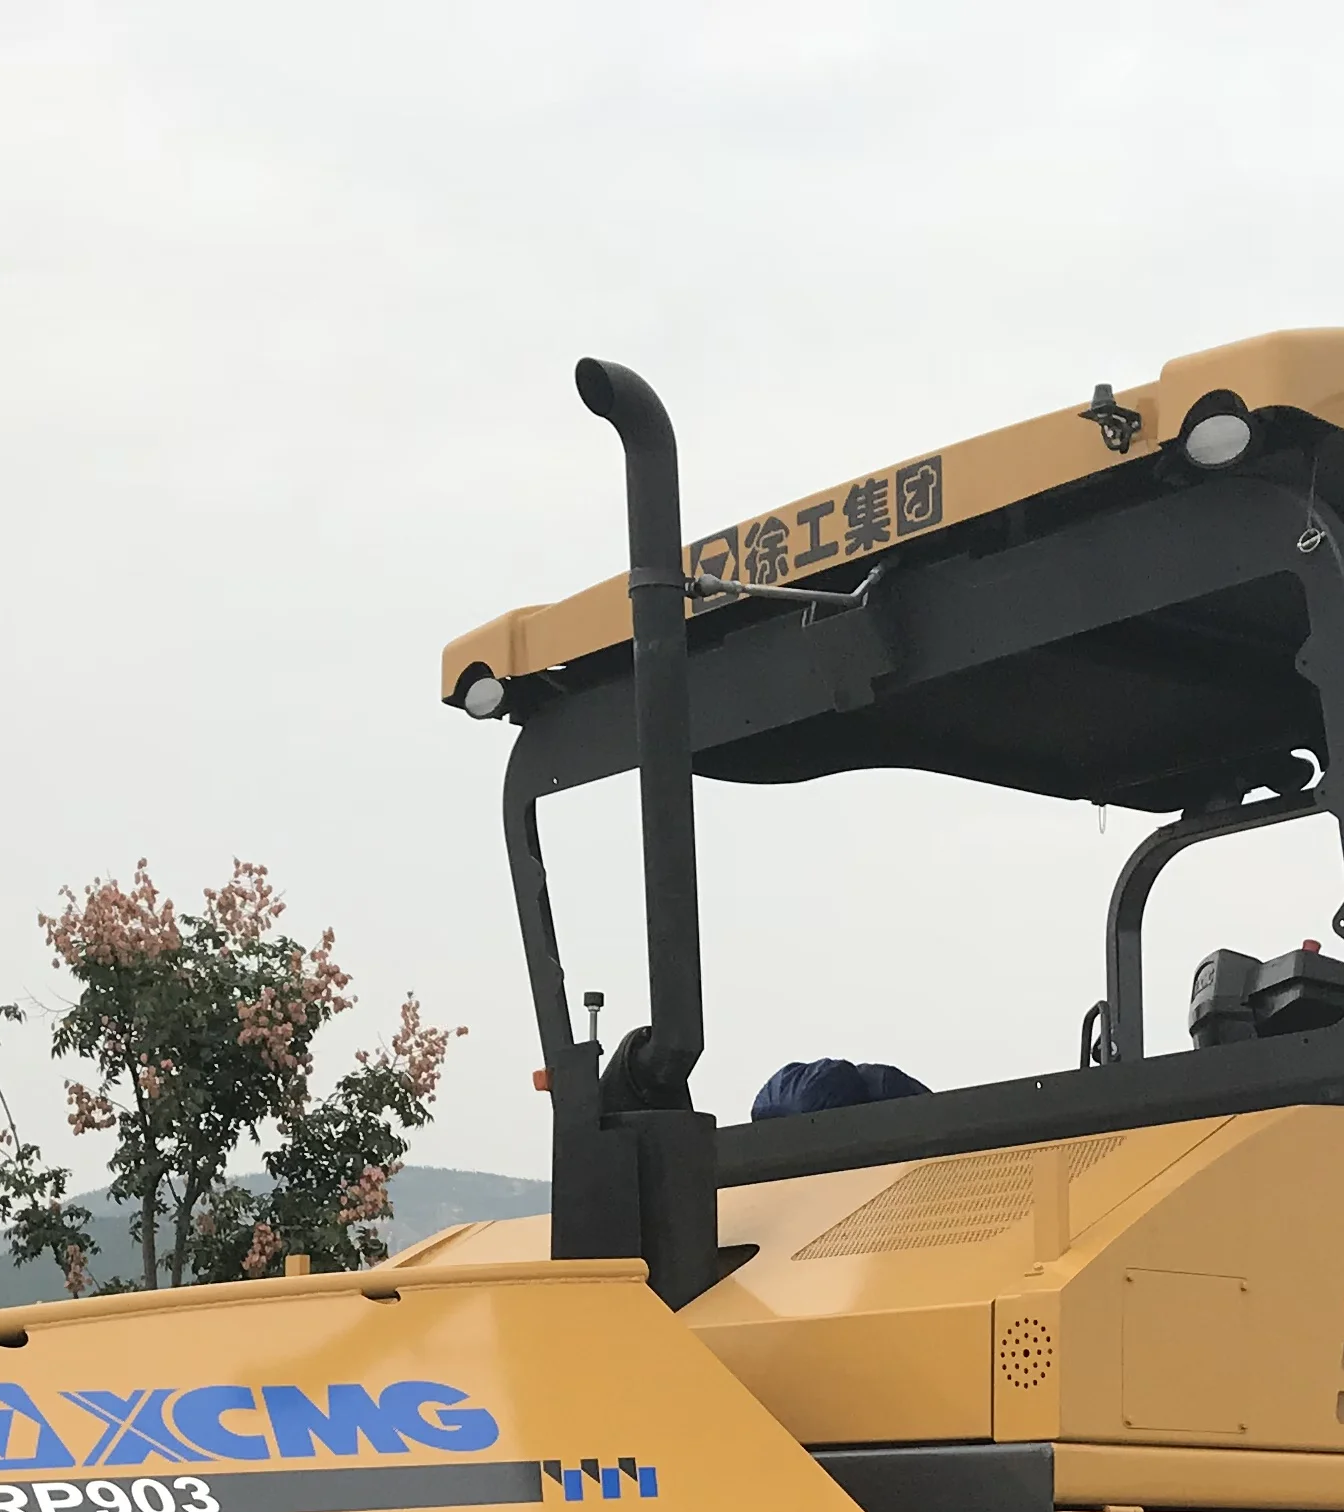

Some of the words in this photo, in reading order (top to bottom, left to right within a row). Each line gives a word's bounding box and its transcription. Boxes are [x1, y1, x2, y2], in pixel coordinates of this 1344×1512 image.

[744, 455, 942, 585] 徐工集团
[56, 1381, 499, 1467] XCMG
